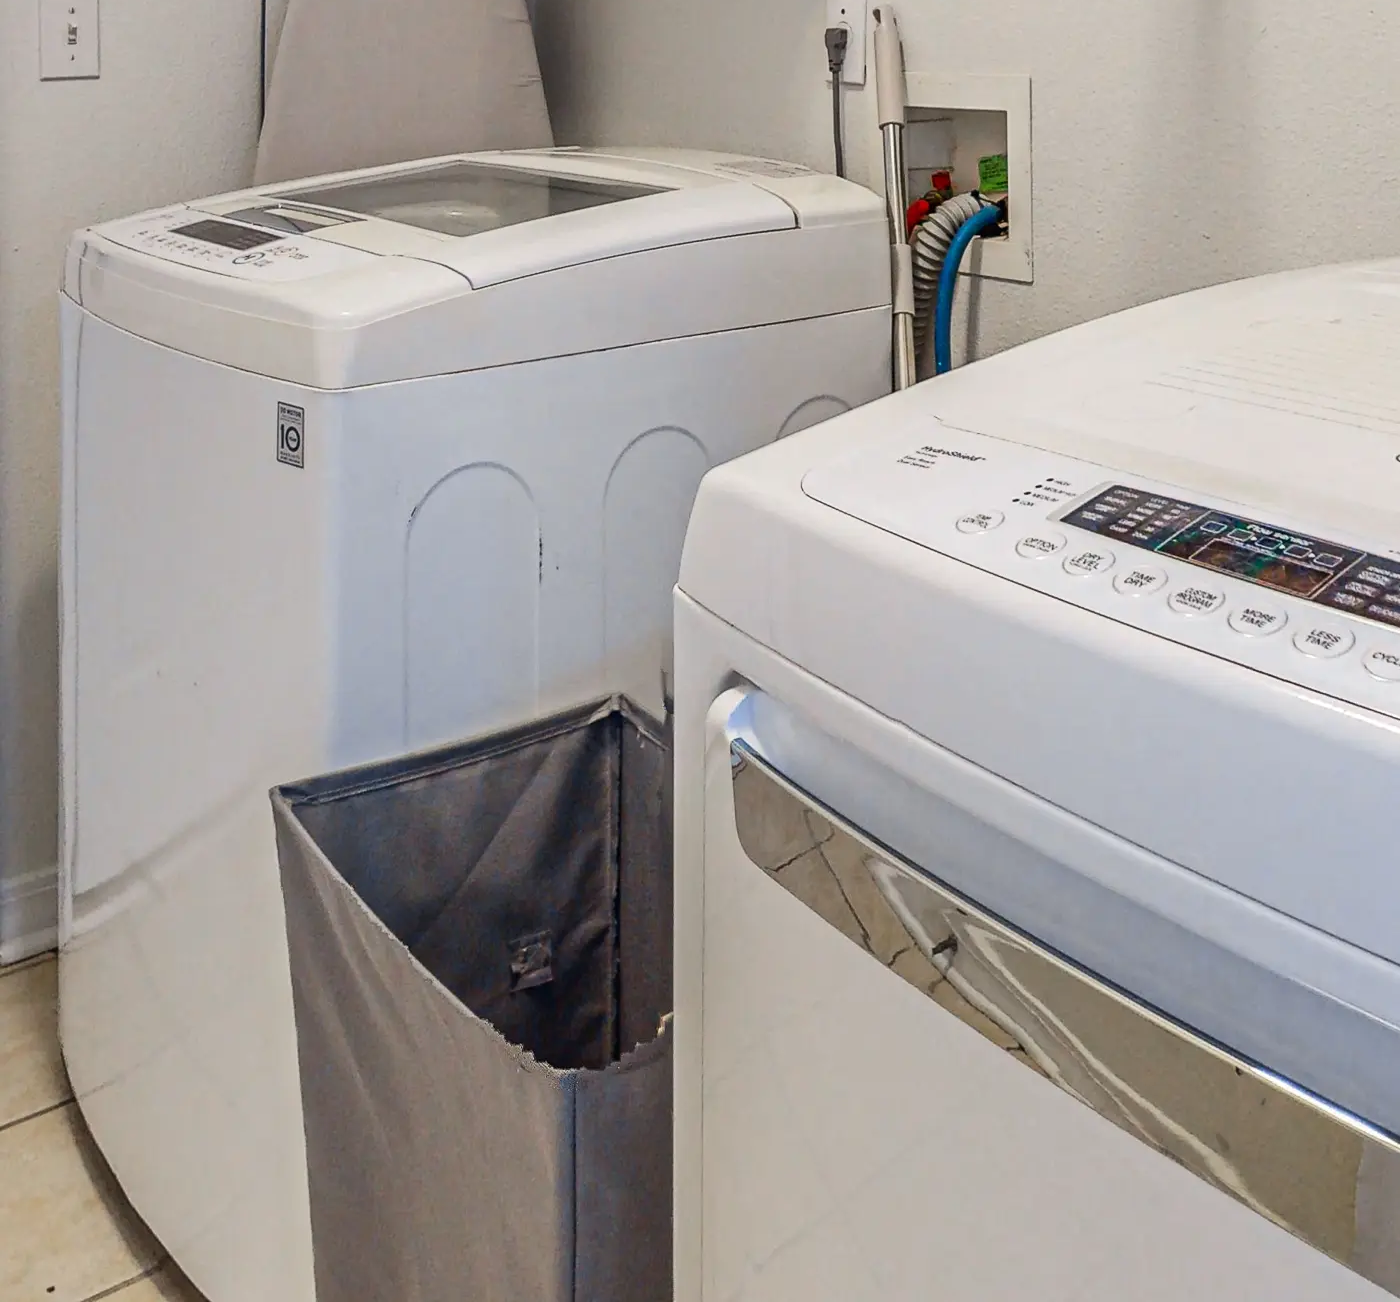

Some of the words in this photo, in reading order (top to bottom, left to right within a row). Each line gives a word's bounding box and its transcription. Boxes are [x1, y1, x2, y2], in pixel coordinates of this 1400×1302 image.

[1024, 537, 1058, 551] OPTION
[1082, 551, 1105, 560] DRY
[1070, 556, 1100, 570] LEVEL
[1123, 577, 1148, 588] DRY
[1131, 571, 1157, 583] TIME
[1239, 614, 1267, 628] TIME
[1243, 608, 1277, 623] MORE
[1304, 635, 1334, 650] TIME
[1310, 628, 1342, 643] LESS
